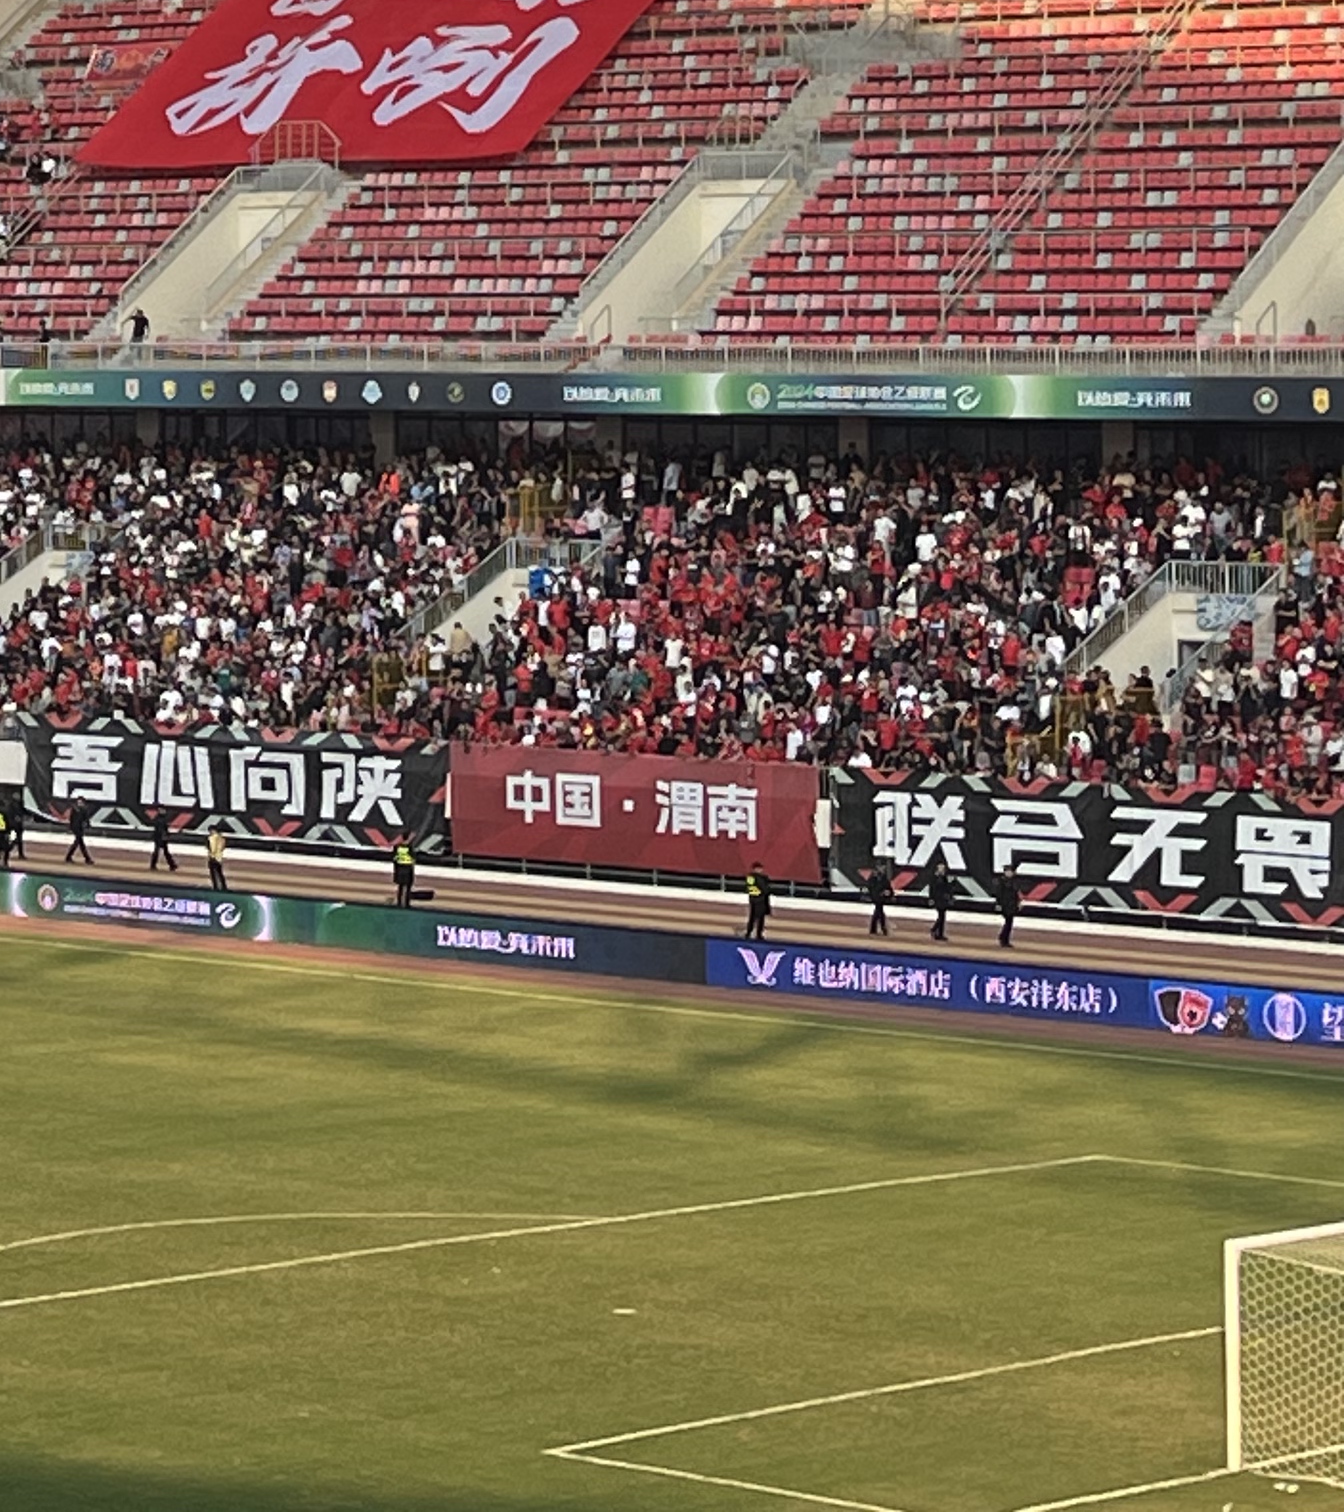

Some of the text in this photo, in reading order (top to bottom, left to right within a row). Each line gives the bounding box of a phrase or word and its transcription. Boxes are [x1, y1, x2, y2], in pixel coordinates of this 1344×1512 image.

[50, 732, 405, 826] 吾心向陕
[505, 768, 759, 841] 中国·渭南
[872, 790, 1332, 899] 联合无畏
